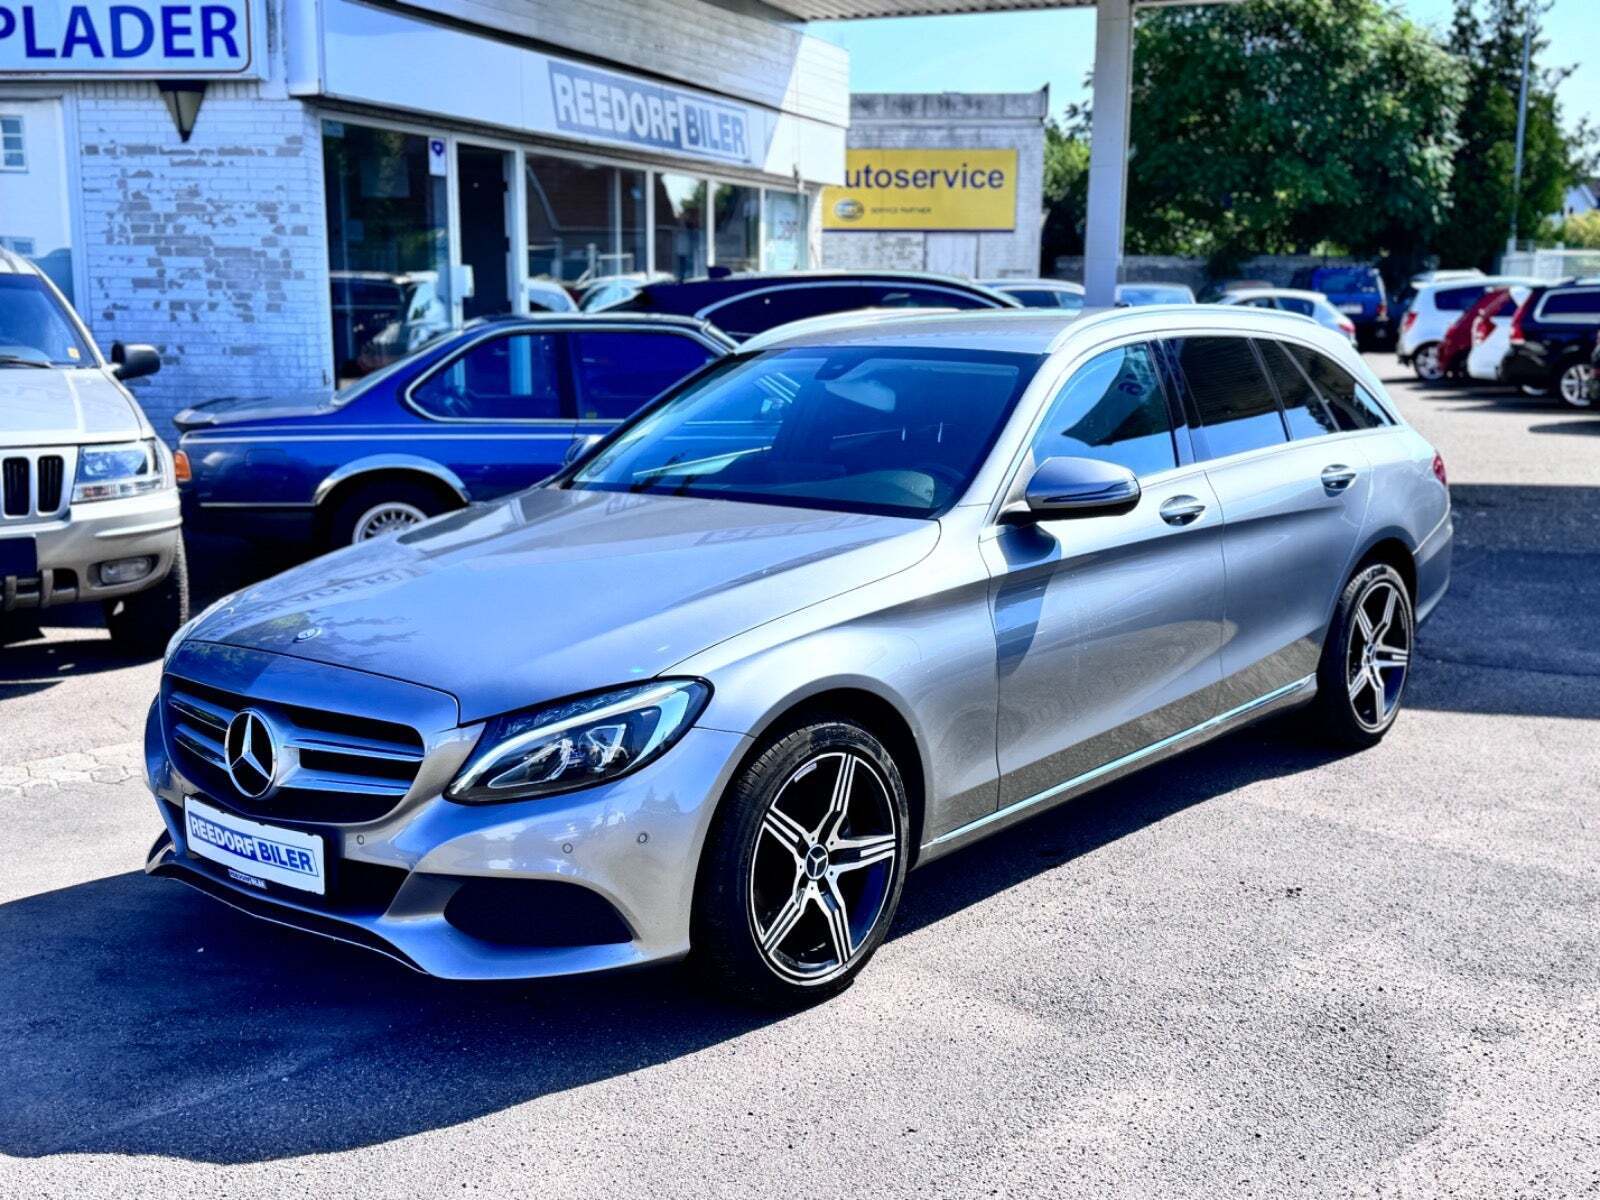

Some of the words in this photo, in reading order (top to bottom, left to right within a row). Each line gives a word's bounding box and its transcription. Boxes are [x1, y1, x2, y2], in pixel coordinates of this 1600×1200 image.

[552, 73, 680, 141] REEDORF
[684, 104, 746, 155] BILER
[845, 163, 1005, 189] utoservice
[190, 816, 254, 856] REEDORF
[258, 841, 313, 872] BILER
